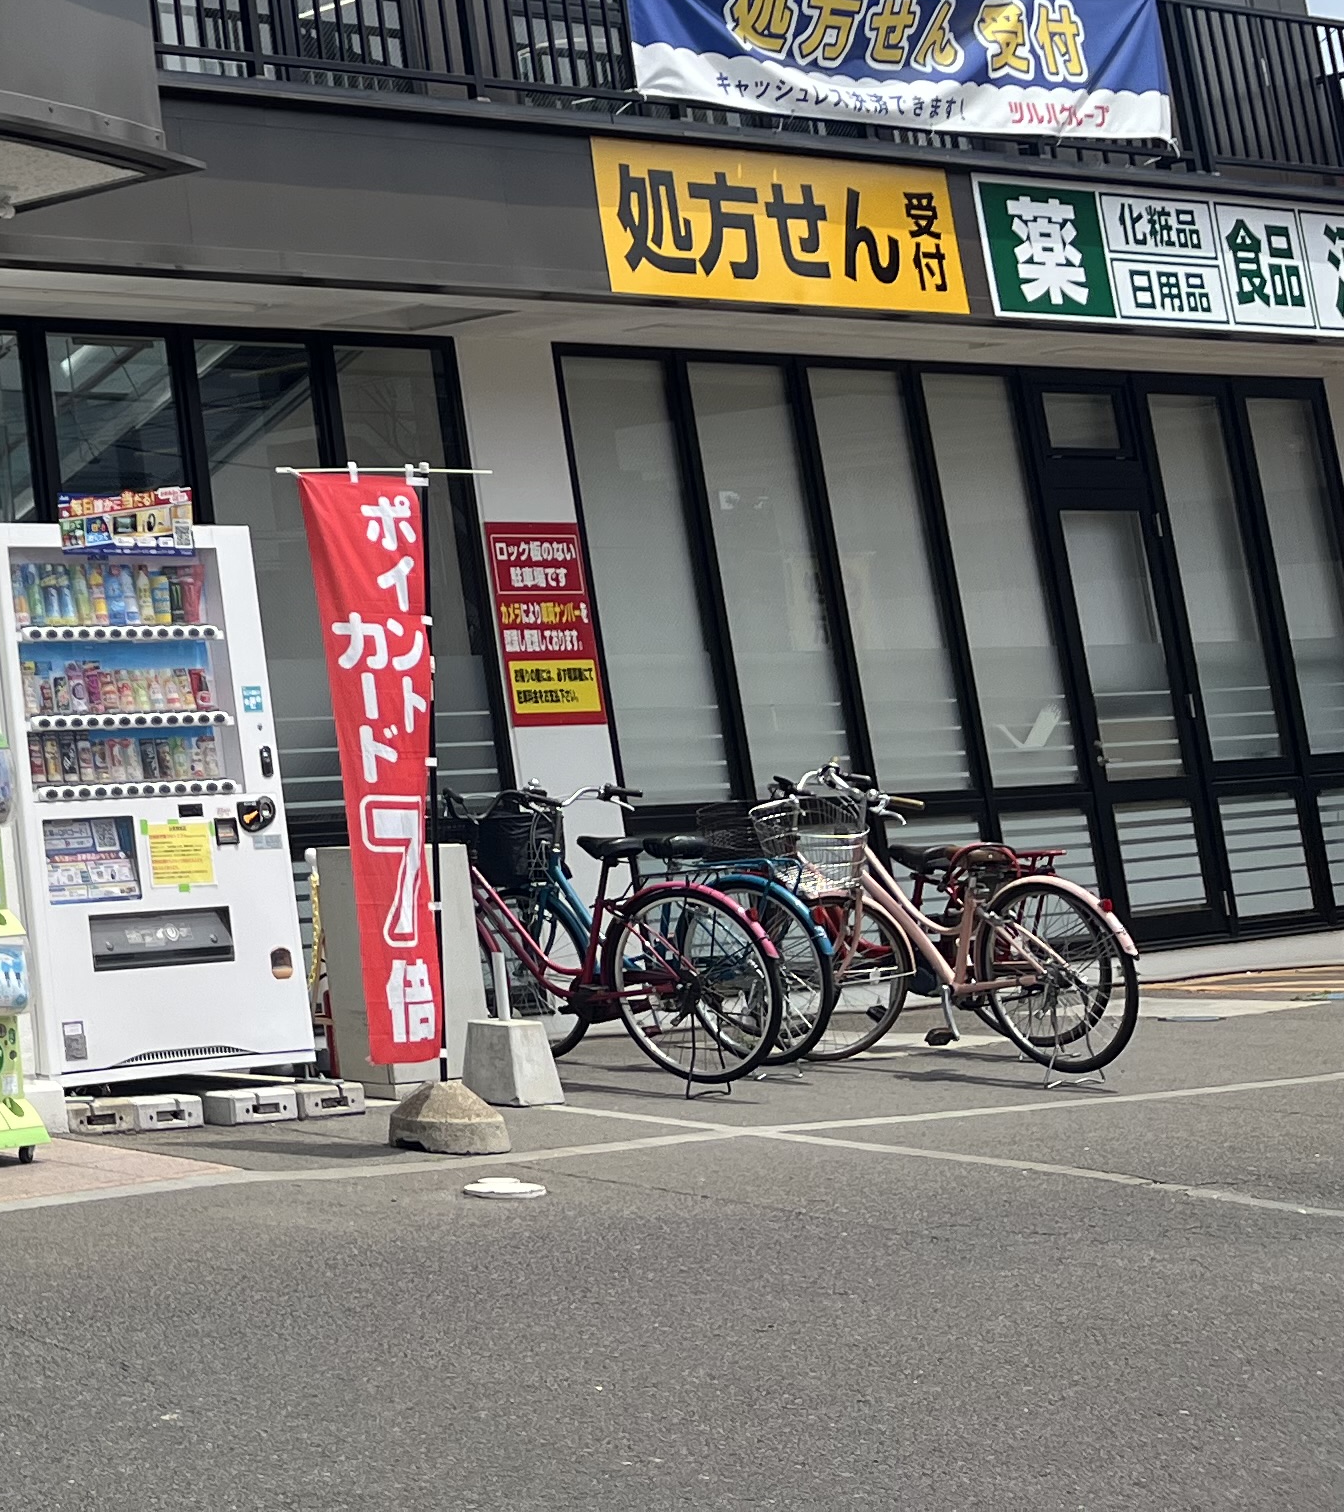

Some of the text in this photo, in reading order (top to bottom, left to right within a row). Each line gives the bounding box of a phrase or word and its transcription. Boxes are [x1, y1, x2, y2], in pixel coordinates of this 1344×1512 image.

[1008, 100, 1109, 128] ツルハグループ
[617, 164, 948, 293] 処方せん 受付
[1006, 196, 1089, 306] 薬
[1118, 202, 1202, 249] 化粧品
[1225, 218, 1306, 308] 食品
[1129, 269, 1212, 313] 日用品
[495, 541, 577, 561] ロック板のない
[510, 567, 567, 588] 駐車場です
[359, 494, 428, 734] ポイント
[331, 612, 400, 783] カード
[361, 794, 438, 1045] 7倍
